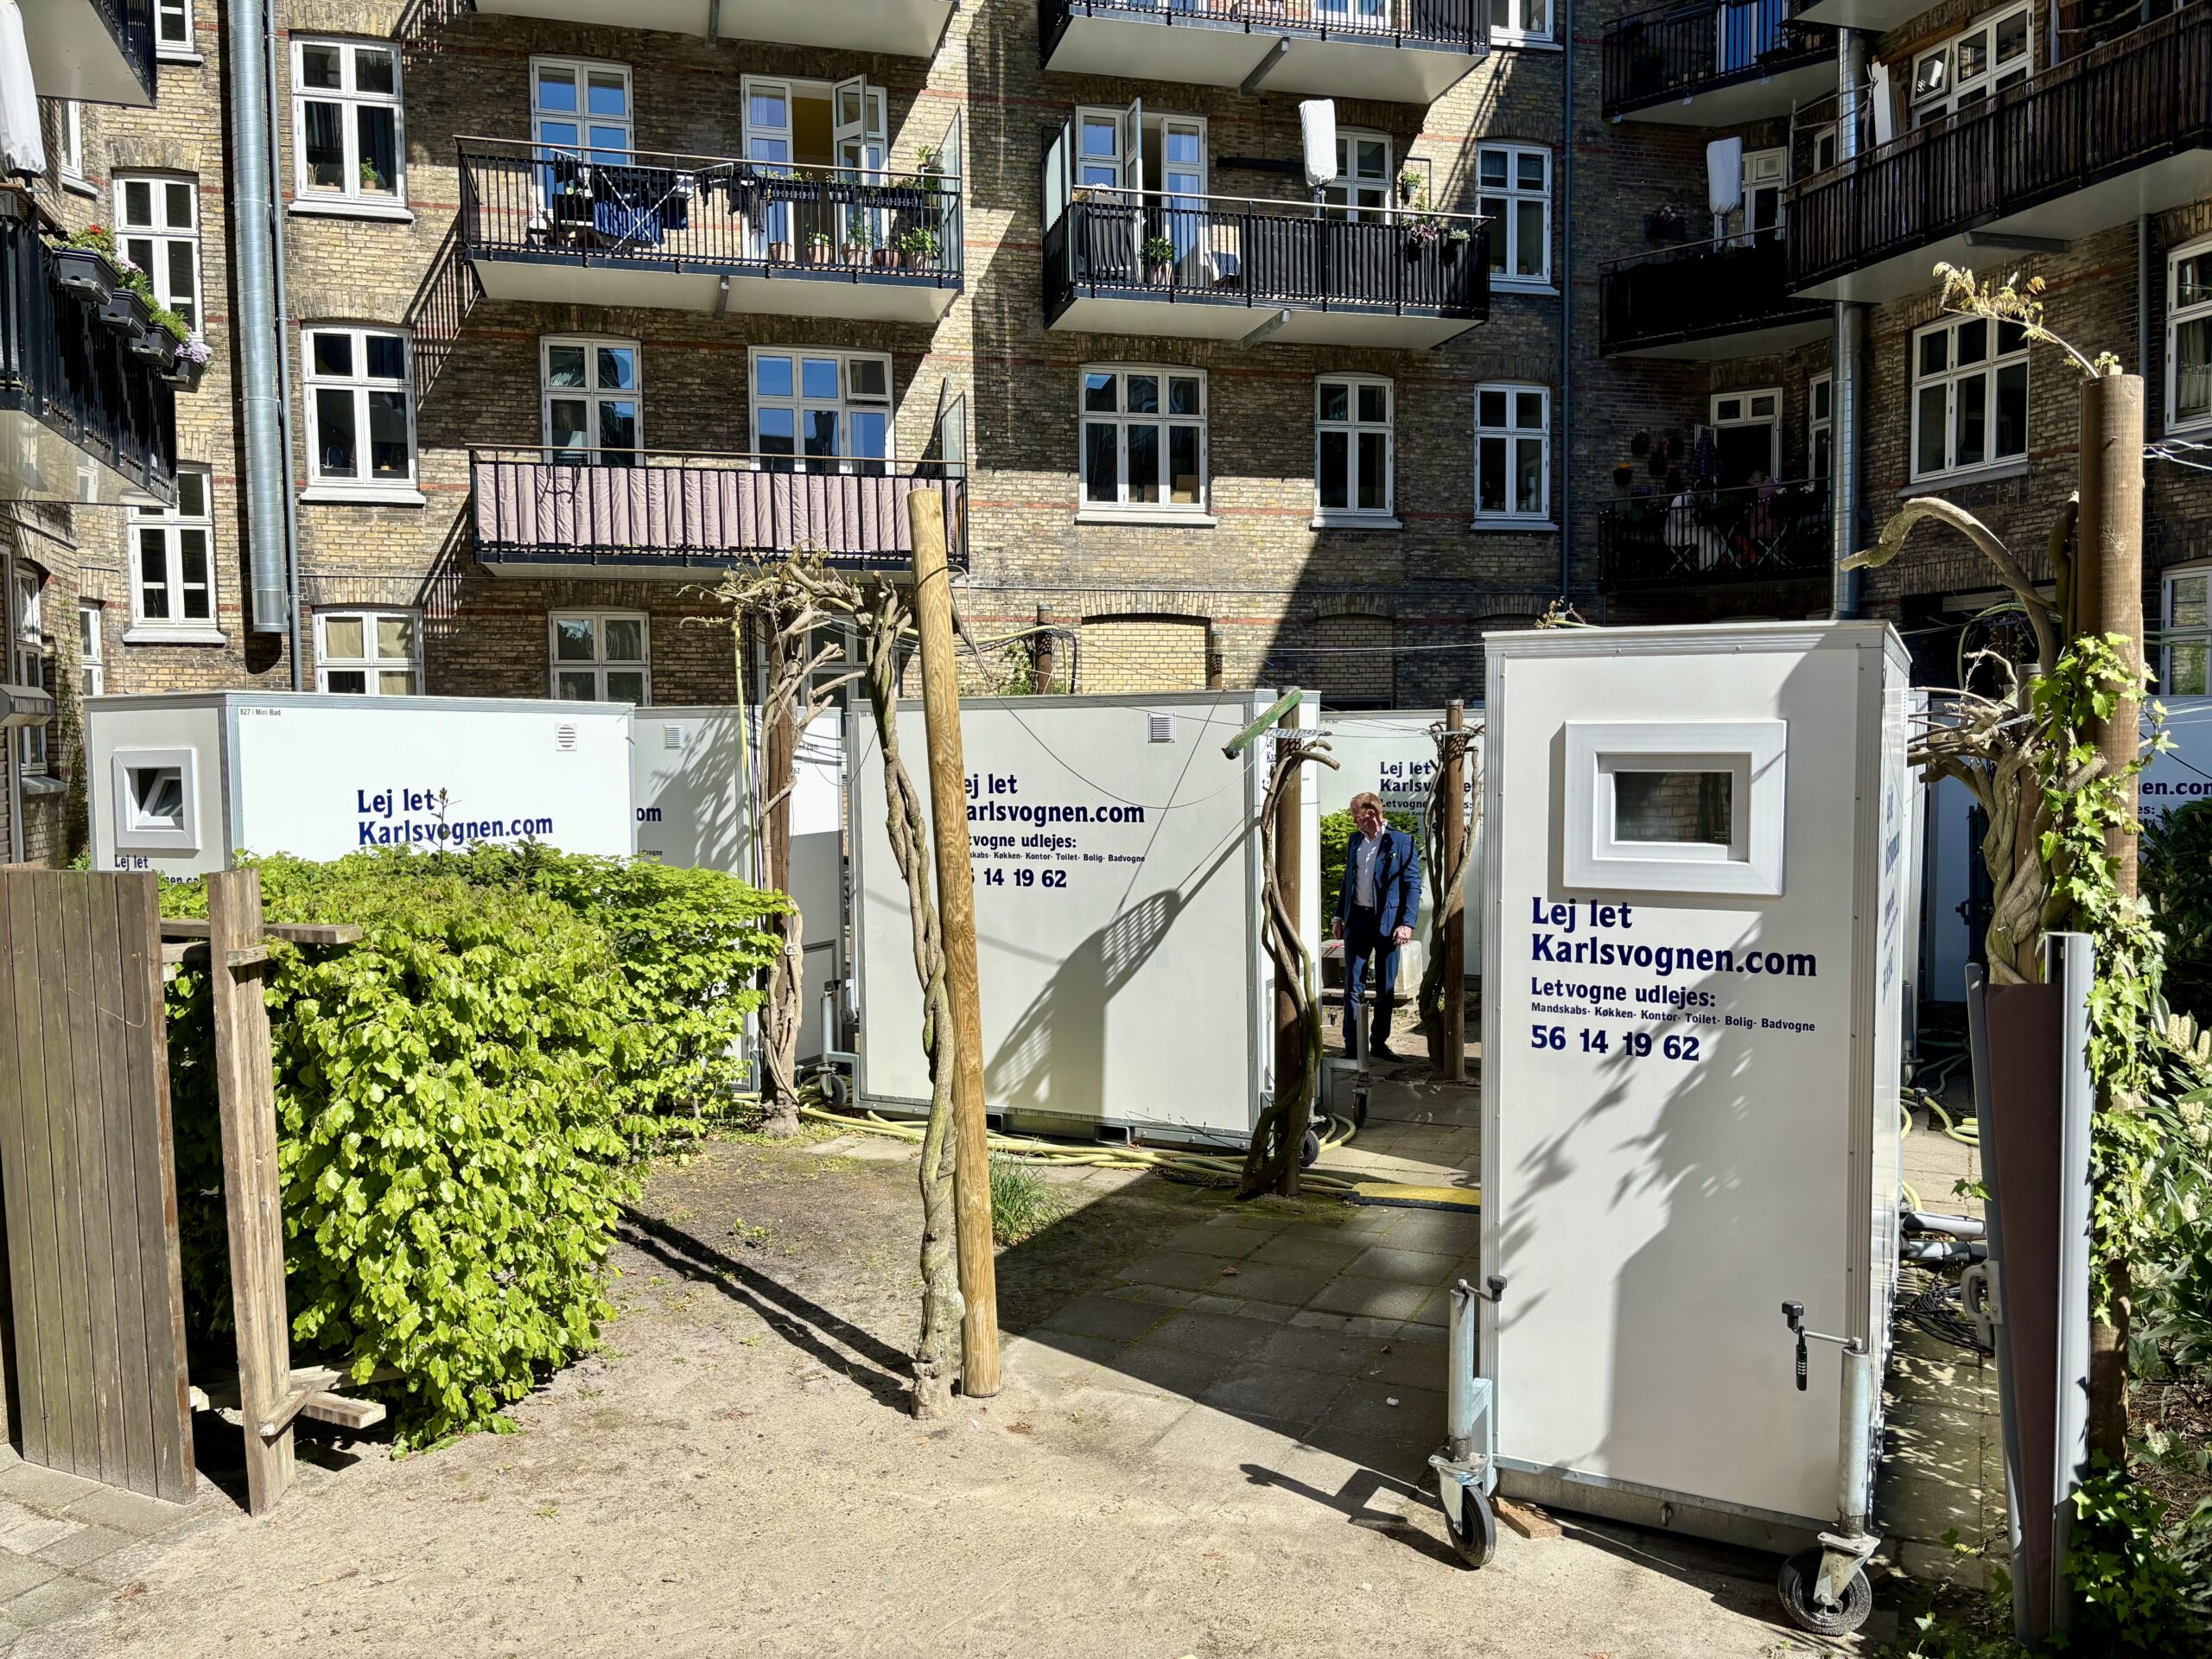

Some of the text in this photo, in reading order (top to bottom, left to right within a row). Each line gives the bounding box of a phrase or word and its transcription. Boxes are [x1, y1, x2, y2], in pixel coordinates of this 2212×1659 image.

[1380, 761, 1432, 778] Lej let
[964, 773, 1018, 799] ej let
[357, 788, 435, 818] Lej let
[967, 800, 1146, 828] arlsvognen.com
[359, 817, 554, 846] Karlsvognen.com
[969, 833, 1077, 851] vogne udlejes:
[114, 854, 149, 871] Lej let
[994, 851, 1023, 860] Køkken-
[1026, 852, 1053, 861] Kontor-
[1056, 853, 1080, 861] Toilet-
[1084, 854, 1105, 863] Bolig-
[1109, 854, 1146, 863] Badvogne
[983, 868, 1005, 886] 14
[1014, 868, 1034, 887] 19
[1041, 869, 1067, 888] 62
[1531, 896, 1633, 934] Lej let
[1531, 933, 1817, 977] Karlsvognen.com
[1531, 976, 1716, 1010] Letvogne udlejes:
[1531, 1001, 1815, 1033] Mandskabs- Køkken- Kontor- Toilet- Bolig- Badvogne
[1531, 1024, 1700, 1062] 56 14 19 62
